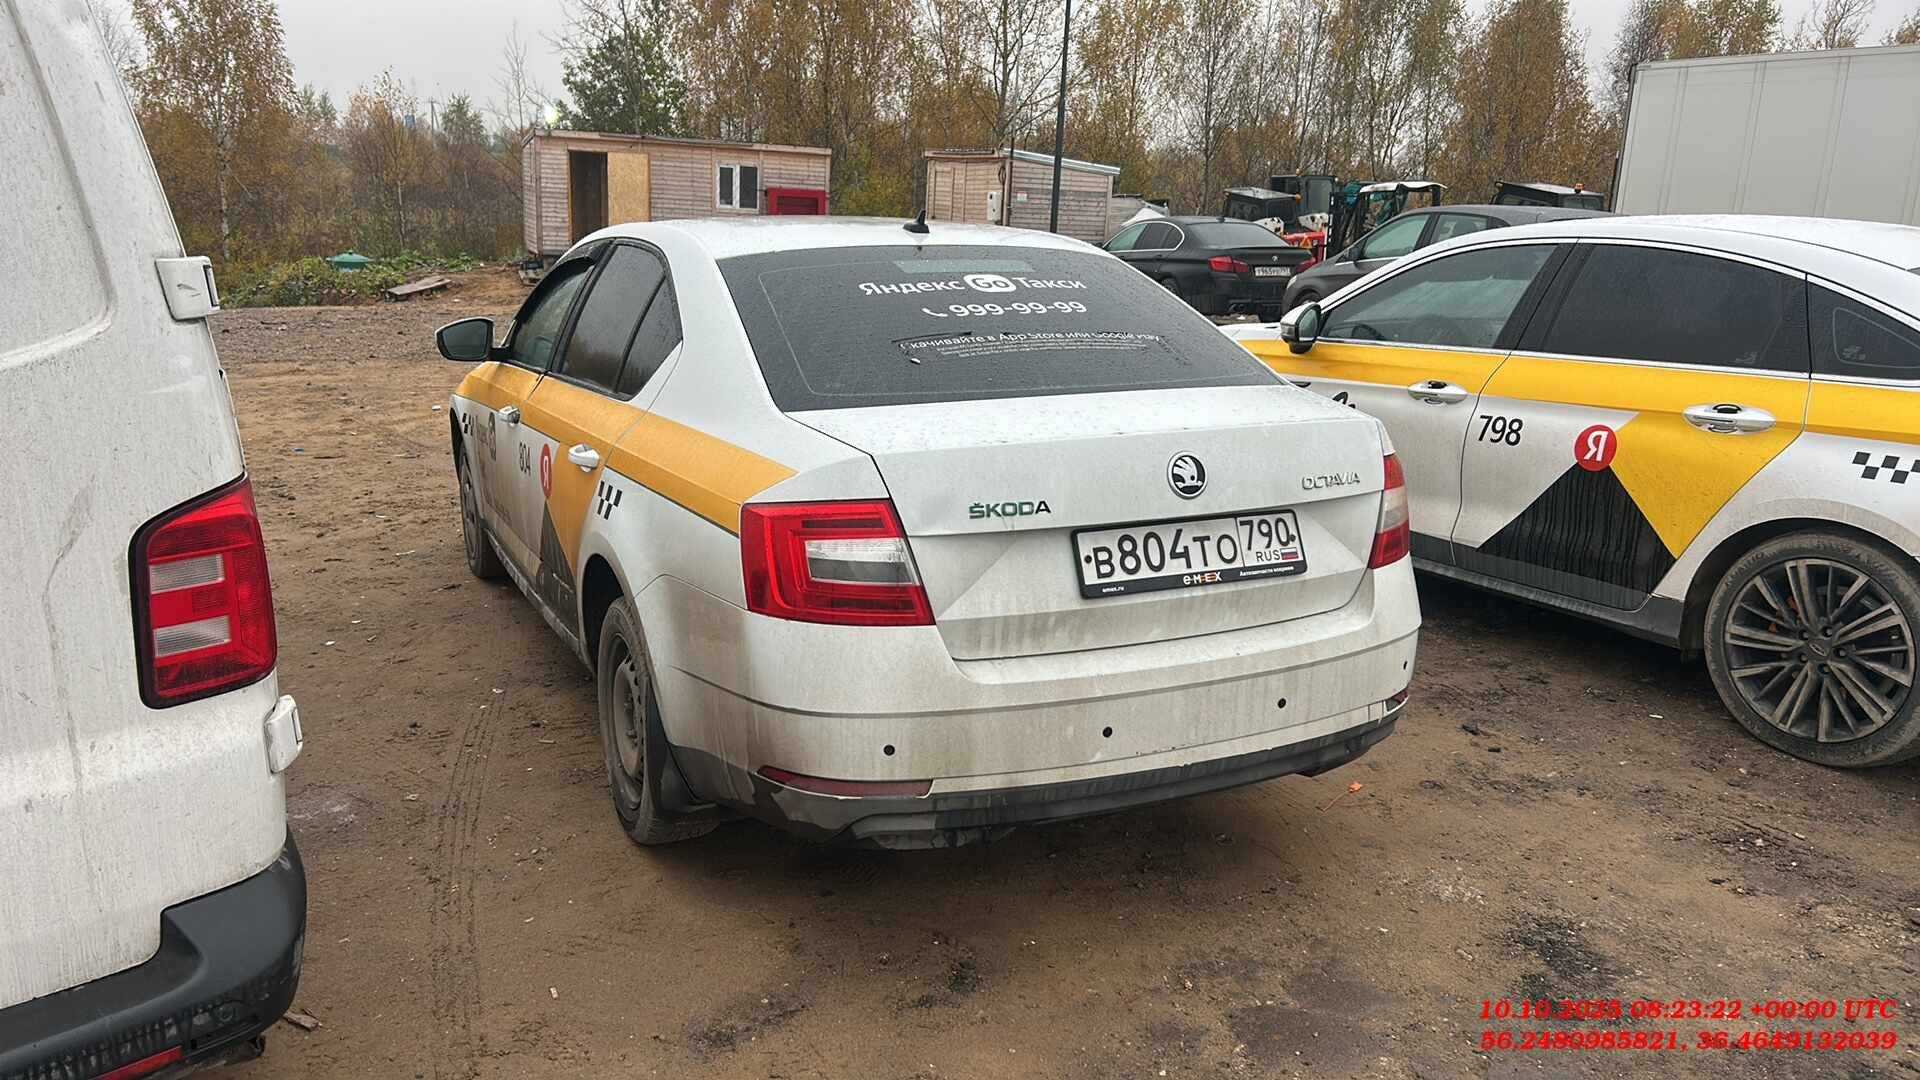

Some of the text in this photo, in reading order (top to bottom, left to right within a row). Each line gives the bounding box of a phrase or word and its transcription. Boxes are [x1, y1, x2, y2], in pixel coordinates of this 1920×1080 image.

[858, 276, 1087, 296] Яндекс Go Такси
[949, 300, 1087, 317] 999-99-99
[1000, 332, 1027, 342] App
[1478, 415, 1523, 447] 798
[1584, 430, 1608, 461] Я
[519, 441, 532, 477] 804
[1302, 471, 1360, 490] OCTAVIA
[968, 500, 1051, 520] ŠKODA
[1239, 517, 1290, 550] 790
[1255, 550, 1280, 562] RUS
